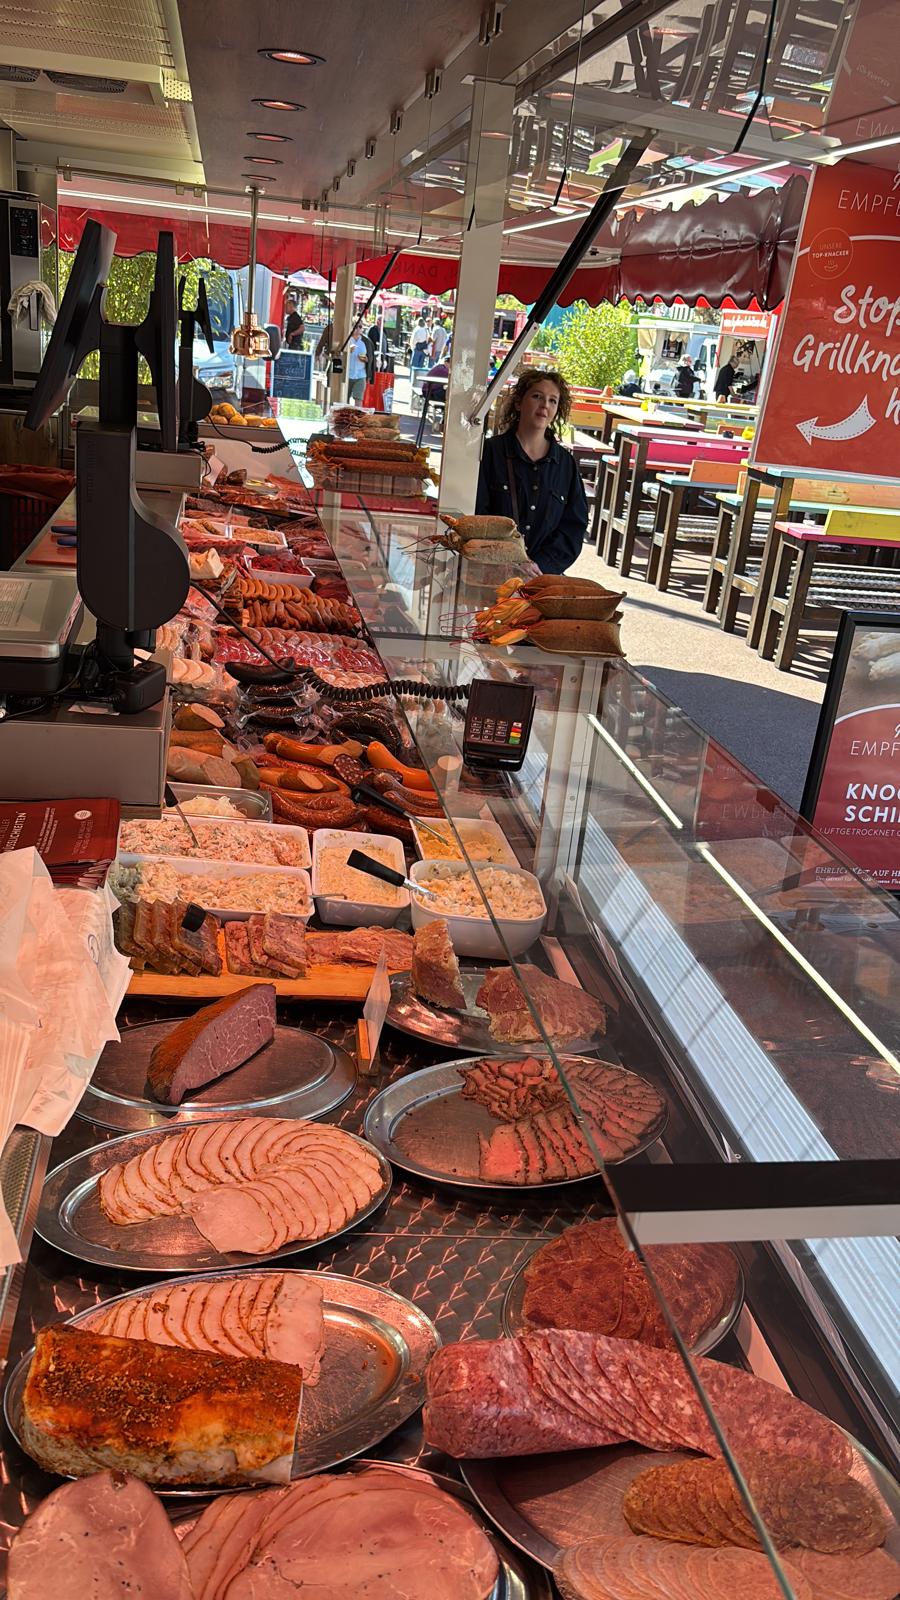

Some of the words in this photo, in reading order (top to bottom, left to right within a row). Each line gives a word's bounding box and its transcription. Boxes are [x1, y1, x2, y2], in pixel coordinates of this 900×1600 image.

[812, 249, 849, 259] TOP-KNACKER
[846, 783, 900, 801] KNO
[844, 805, 900, 823] SCHI
[872, 869, 889, 877] AUF
